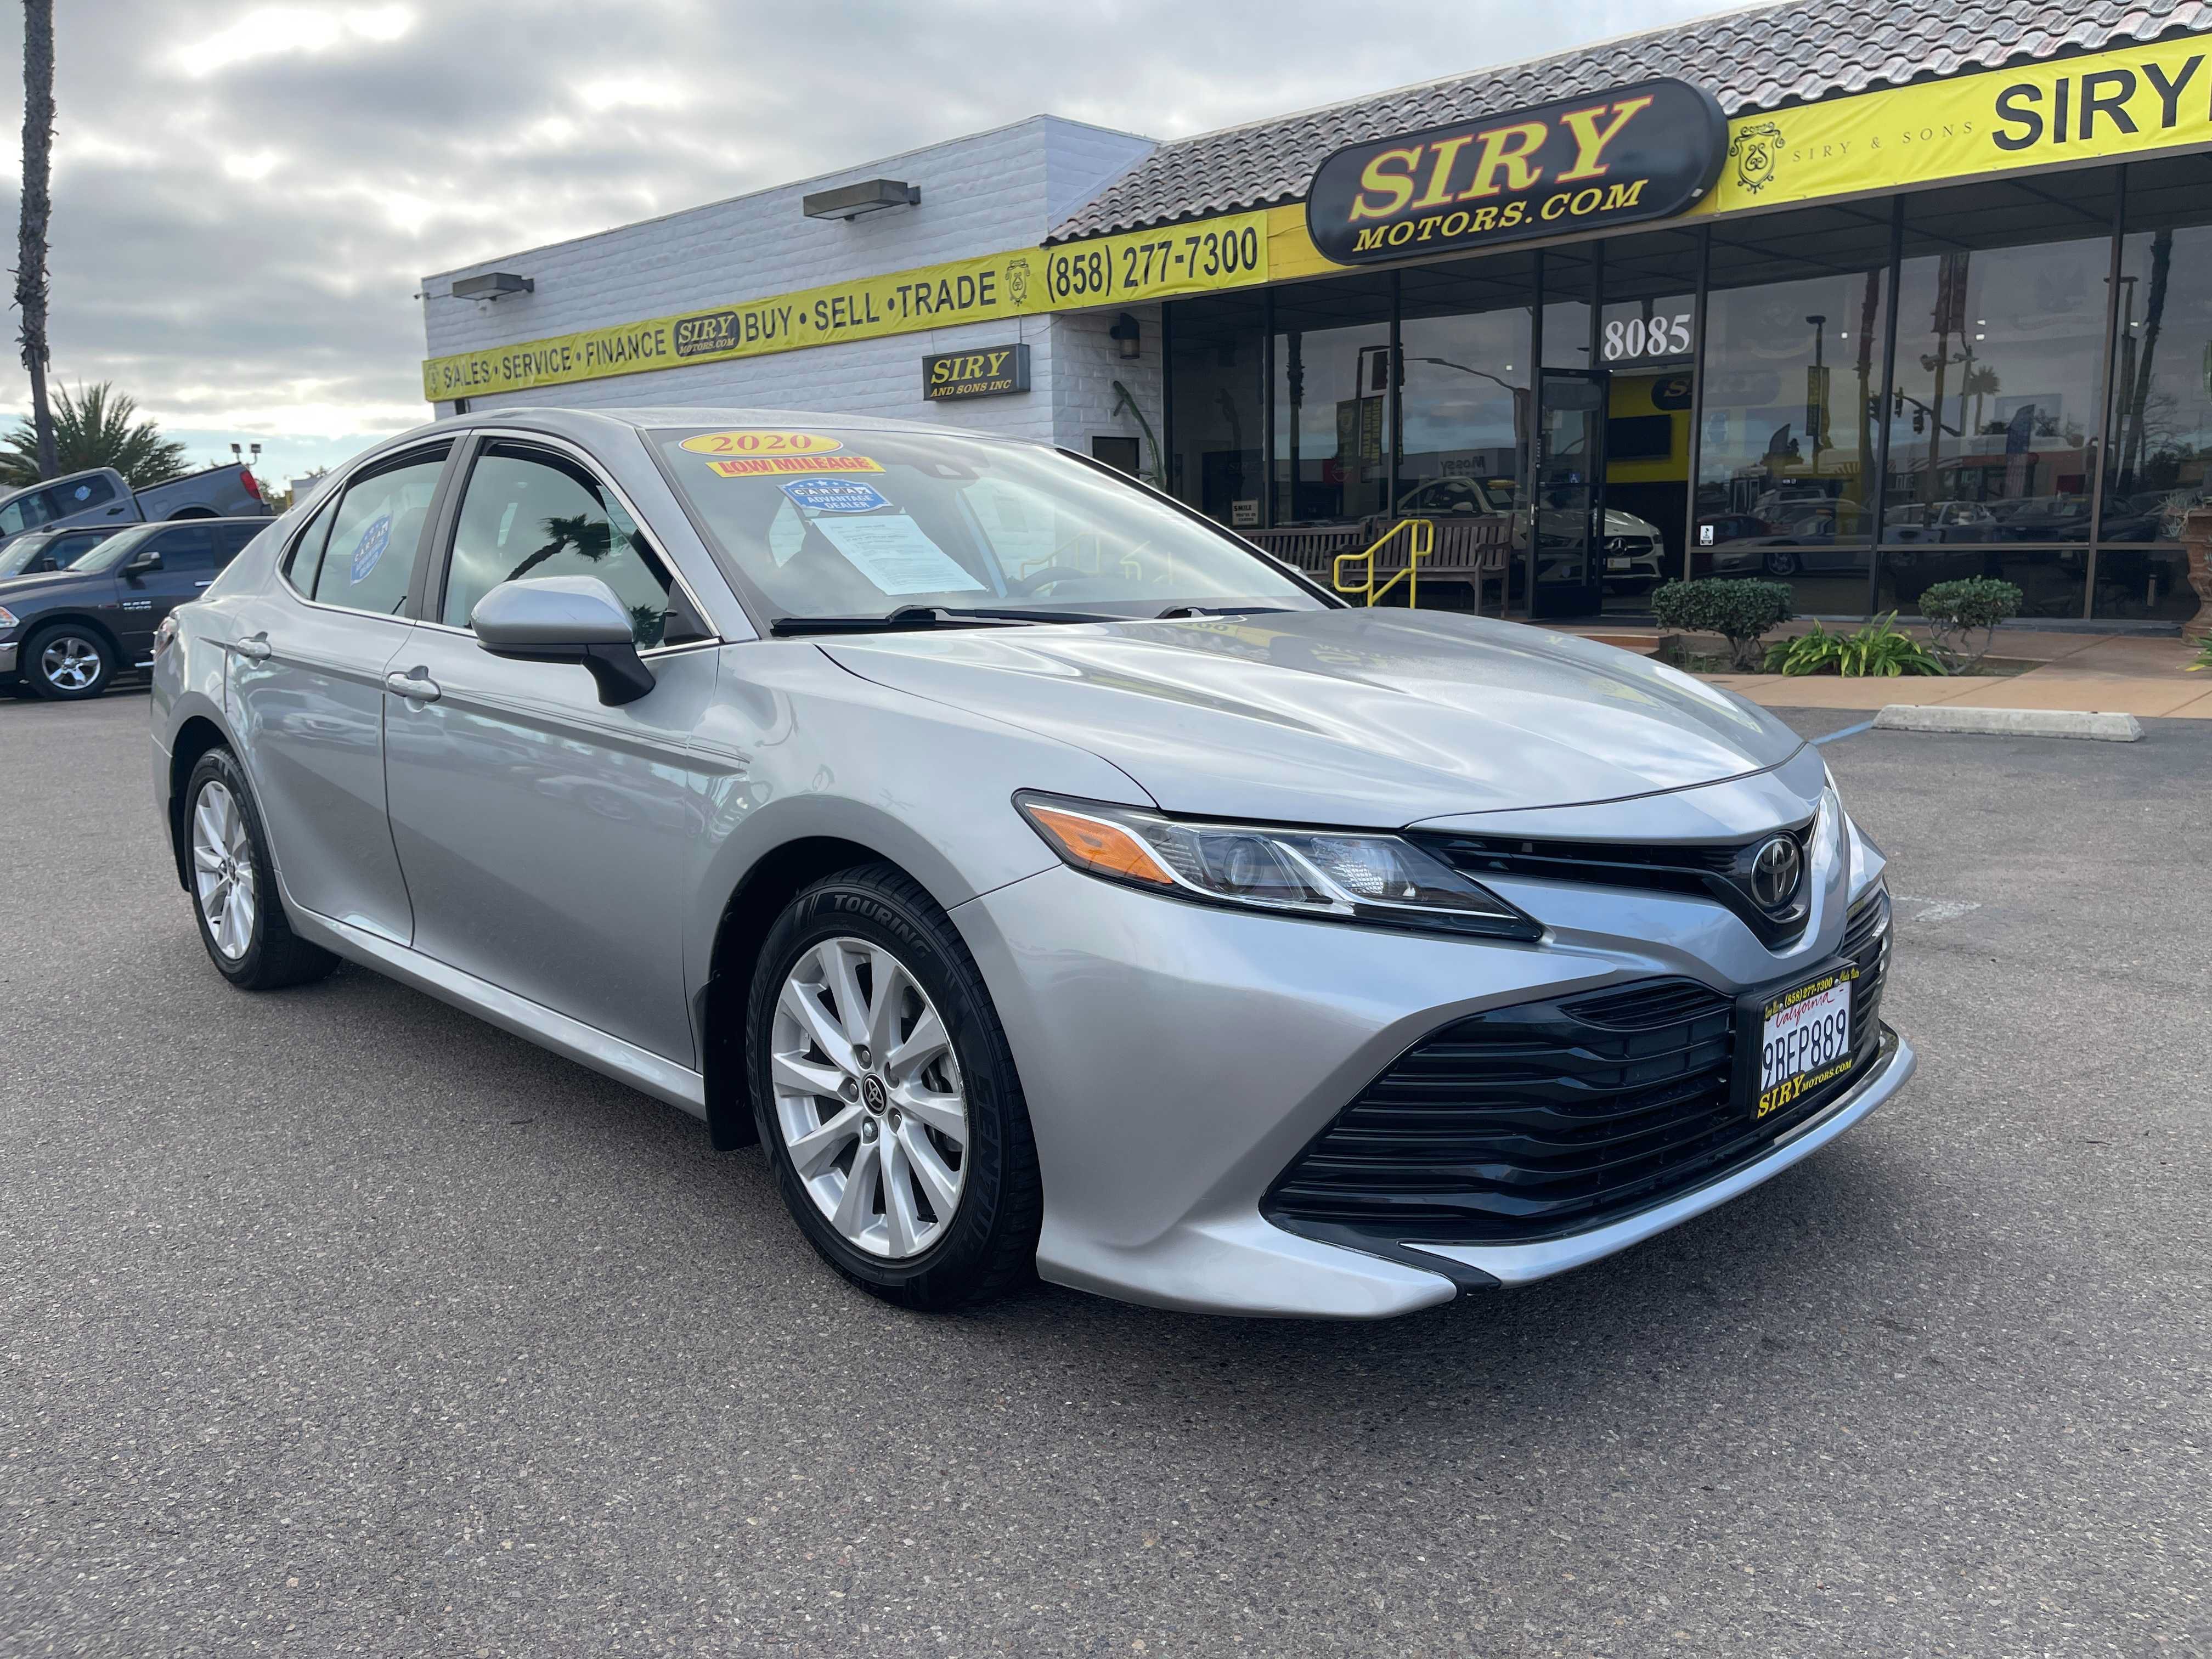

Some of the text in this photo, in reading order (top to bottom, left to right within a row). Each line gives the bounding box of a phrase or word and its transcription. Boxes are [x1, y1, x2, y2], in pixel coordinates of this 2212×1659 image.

[1991, 54, 2212, 151] SIRY
[1348, 94, 1654, 222] SIRY
[1792, 121, 1974, 162] SIRY & SONS
[1352, 179, 1649, 252] MOTORS.COM
[1046, 226, 1258, 303] (858) 277-7300
[745, 270, 997, 342] BUY SELL TRADE
[678, 313, 736, 346] SIRY
[679, 337, 735, 355] MOTORS.COM
[1604, 314, 1690, 360] 8085
[443, 330, 665, 389] SALES SERVICE FINANCE
[930, 351, 1011, 384] SIRY
[930, 379, 1012, 398] AND SONS INC
[711, 435, 812, 452] 2020
[718, 456, 871, 475] LOW MILEAGE
[794, 487, 872, 495] CARFAX
[808, 495, 874, 503] ADVANTAGE
[824, 501, 870, 510] DEALER
[834, 895, 931, 959] TOURING
[1776, 991, 1835, 1028] California
[1785, 989, 1803, 1008] (858)
[1763, 1009, 1846, 1091] 9BEP889
[1757, 1059, 1853, 1119] SIRY MOTORS.COM
